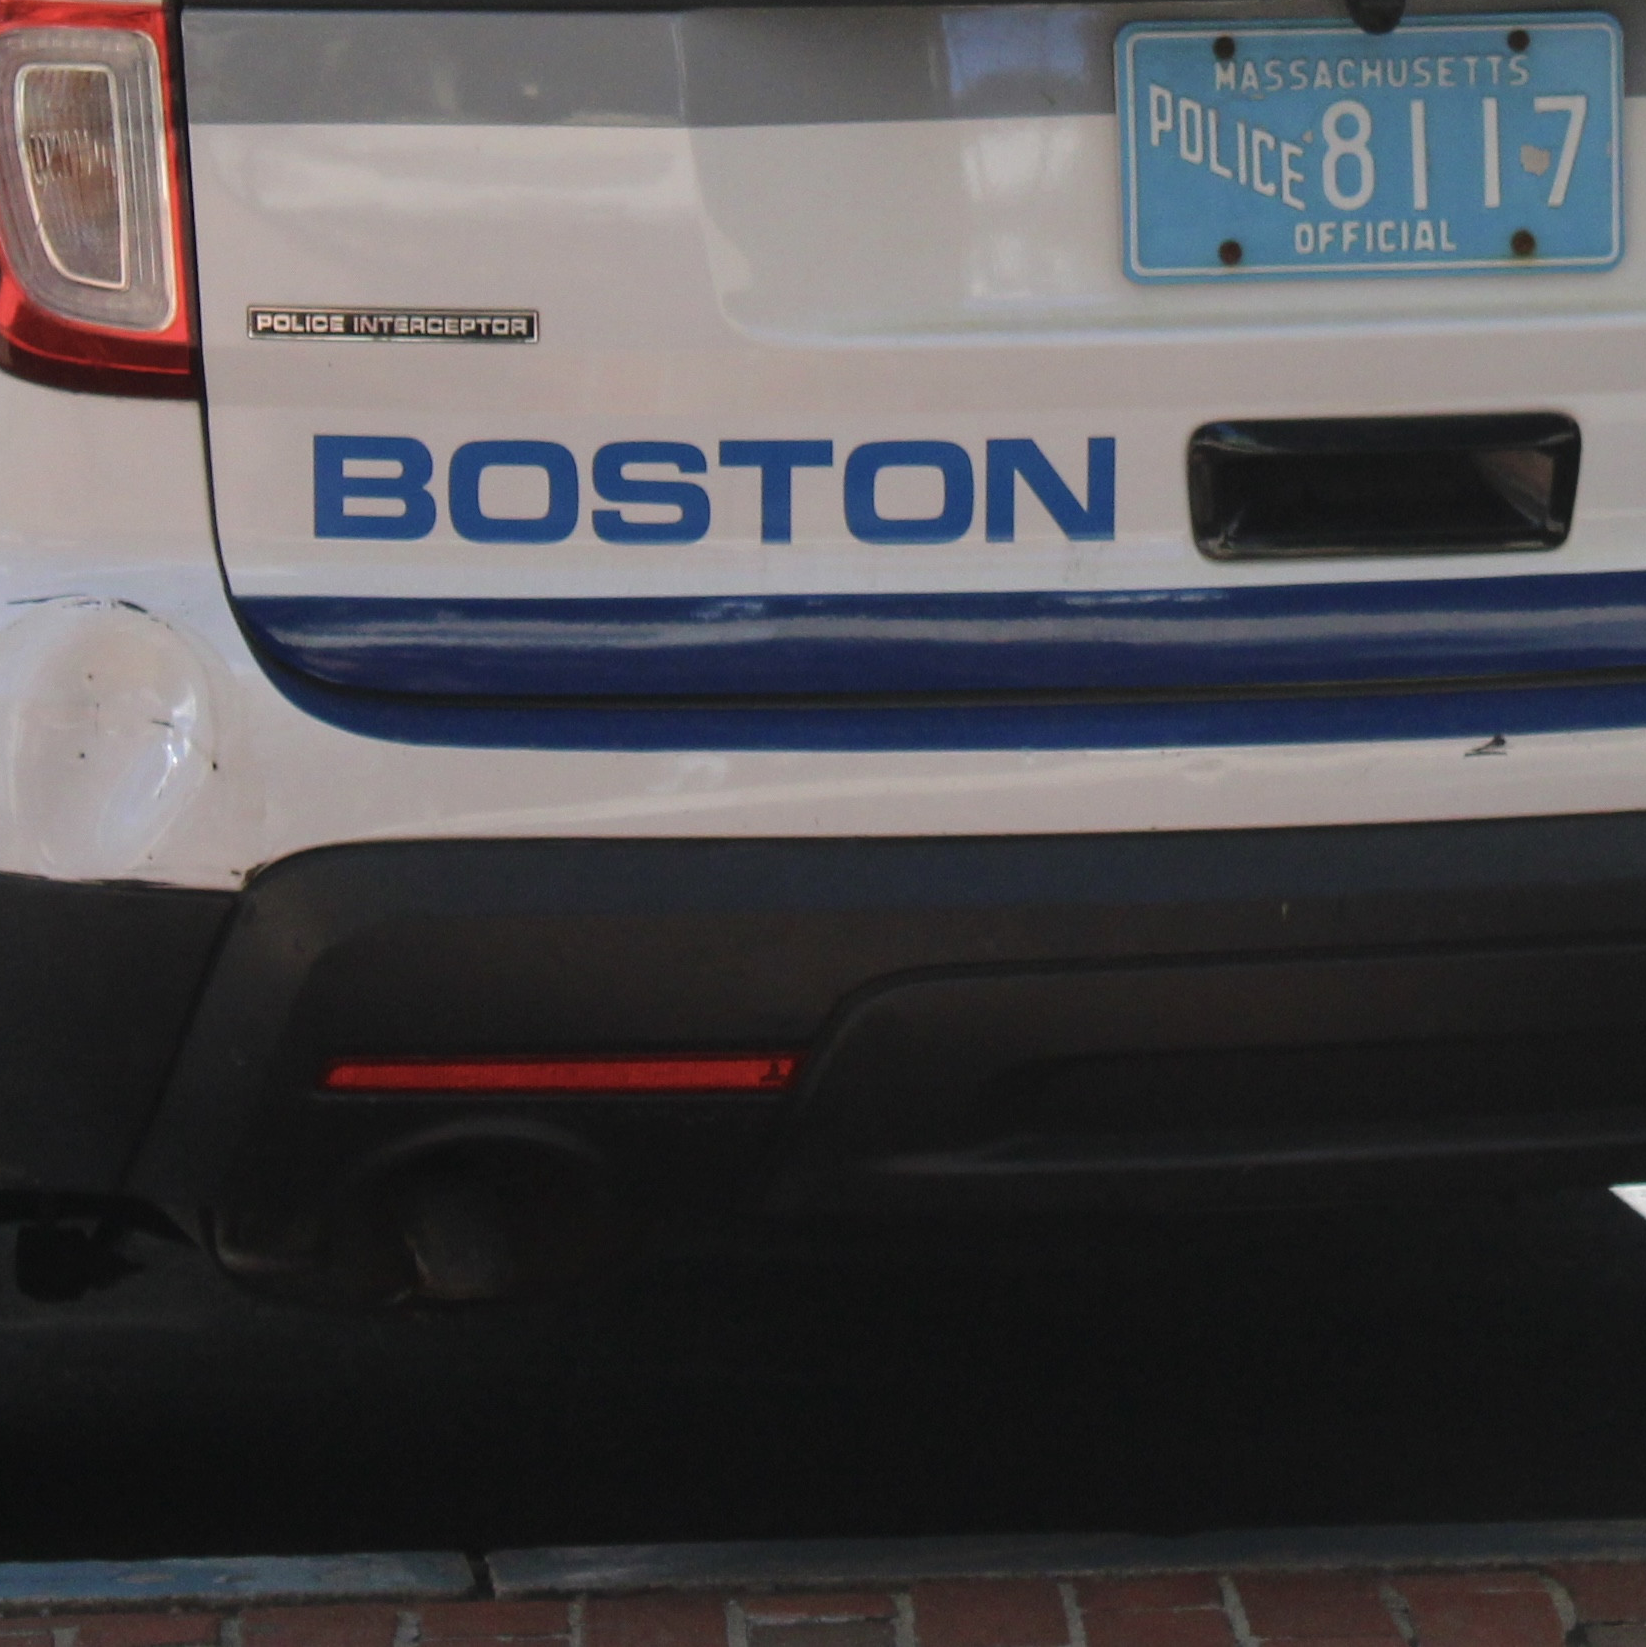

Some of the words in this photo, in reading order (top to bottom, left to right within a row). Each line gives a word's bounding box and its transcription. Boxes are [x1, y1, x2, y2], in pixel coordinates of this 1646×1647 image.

[1215, 57, 1529, 92] MASSACHUSETTS
[1149, 84, 1305, 211] POLICE
[1321, 95, 1587, 212] 8117
[1294, 219, 1457, 254] OFFICIAL
[256, 313, 345, 333] POLICE
[353, 316, 527, 336] INTERCEPTOR
[313, 435, 1116, 544] BOSTON
